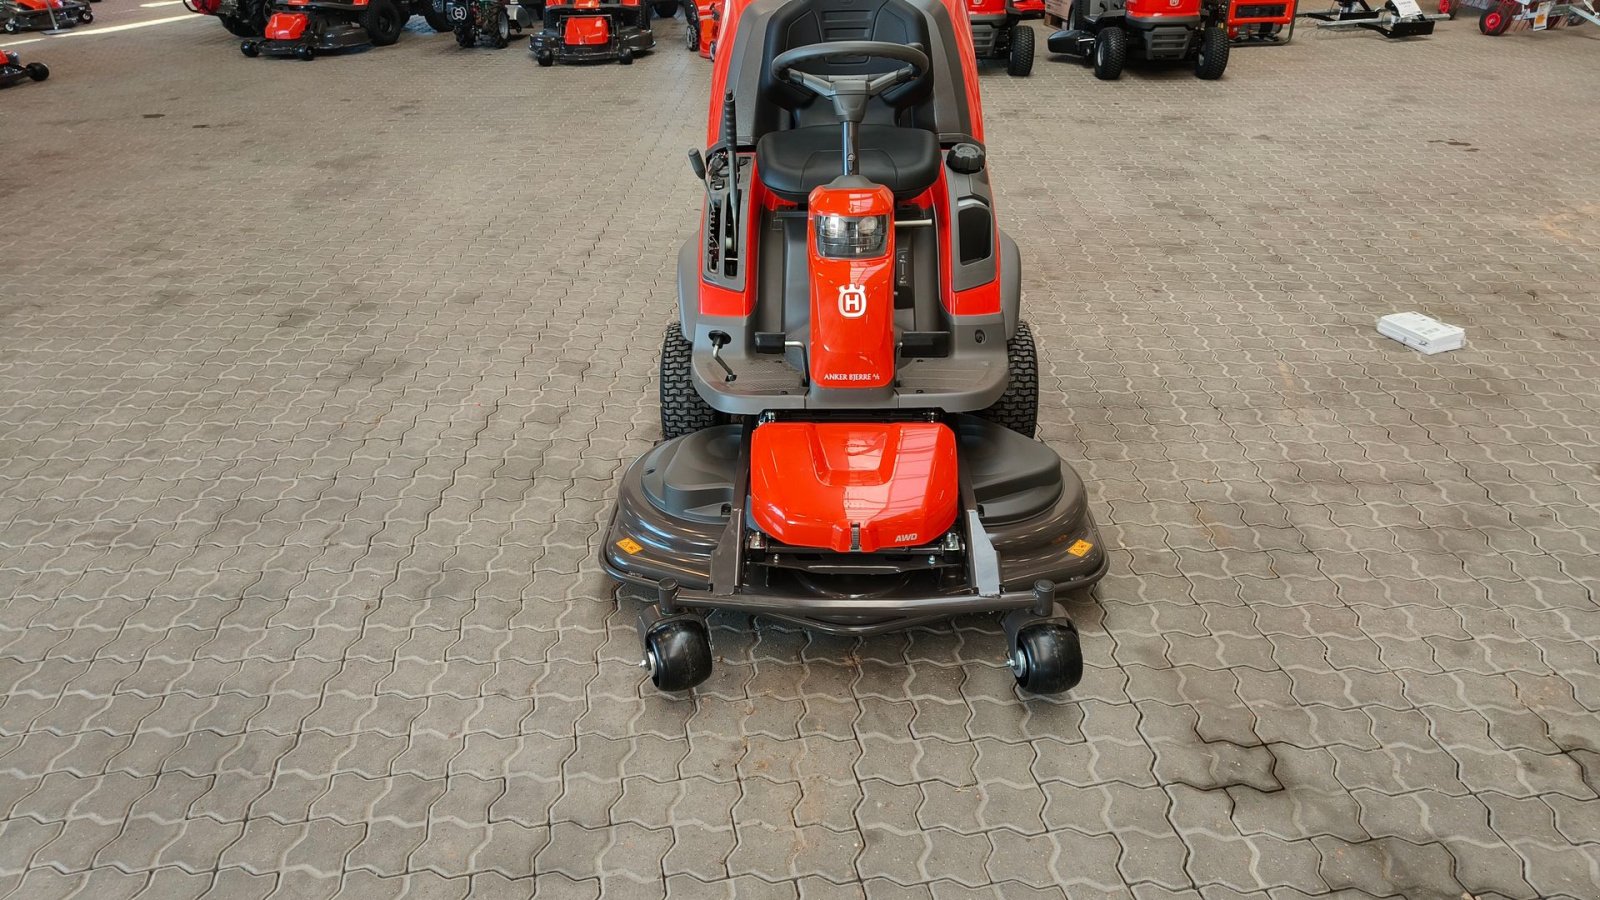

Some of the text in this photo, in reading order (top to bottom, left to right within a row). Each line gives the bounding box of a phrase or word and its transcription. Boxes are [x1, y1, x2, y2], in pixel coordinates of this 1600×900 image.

[824, 373, 848, 381] ANKER
[849, 373, 871, 382] BJERRE
[894, 533, 917, 542] AWD
